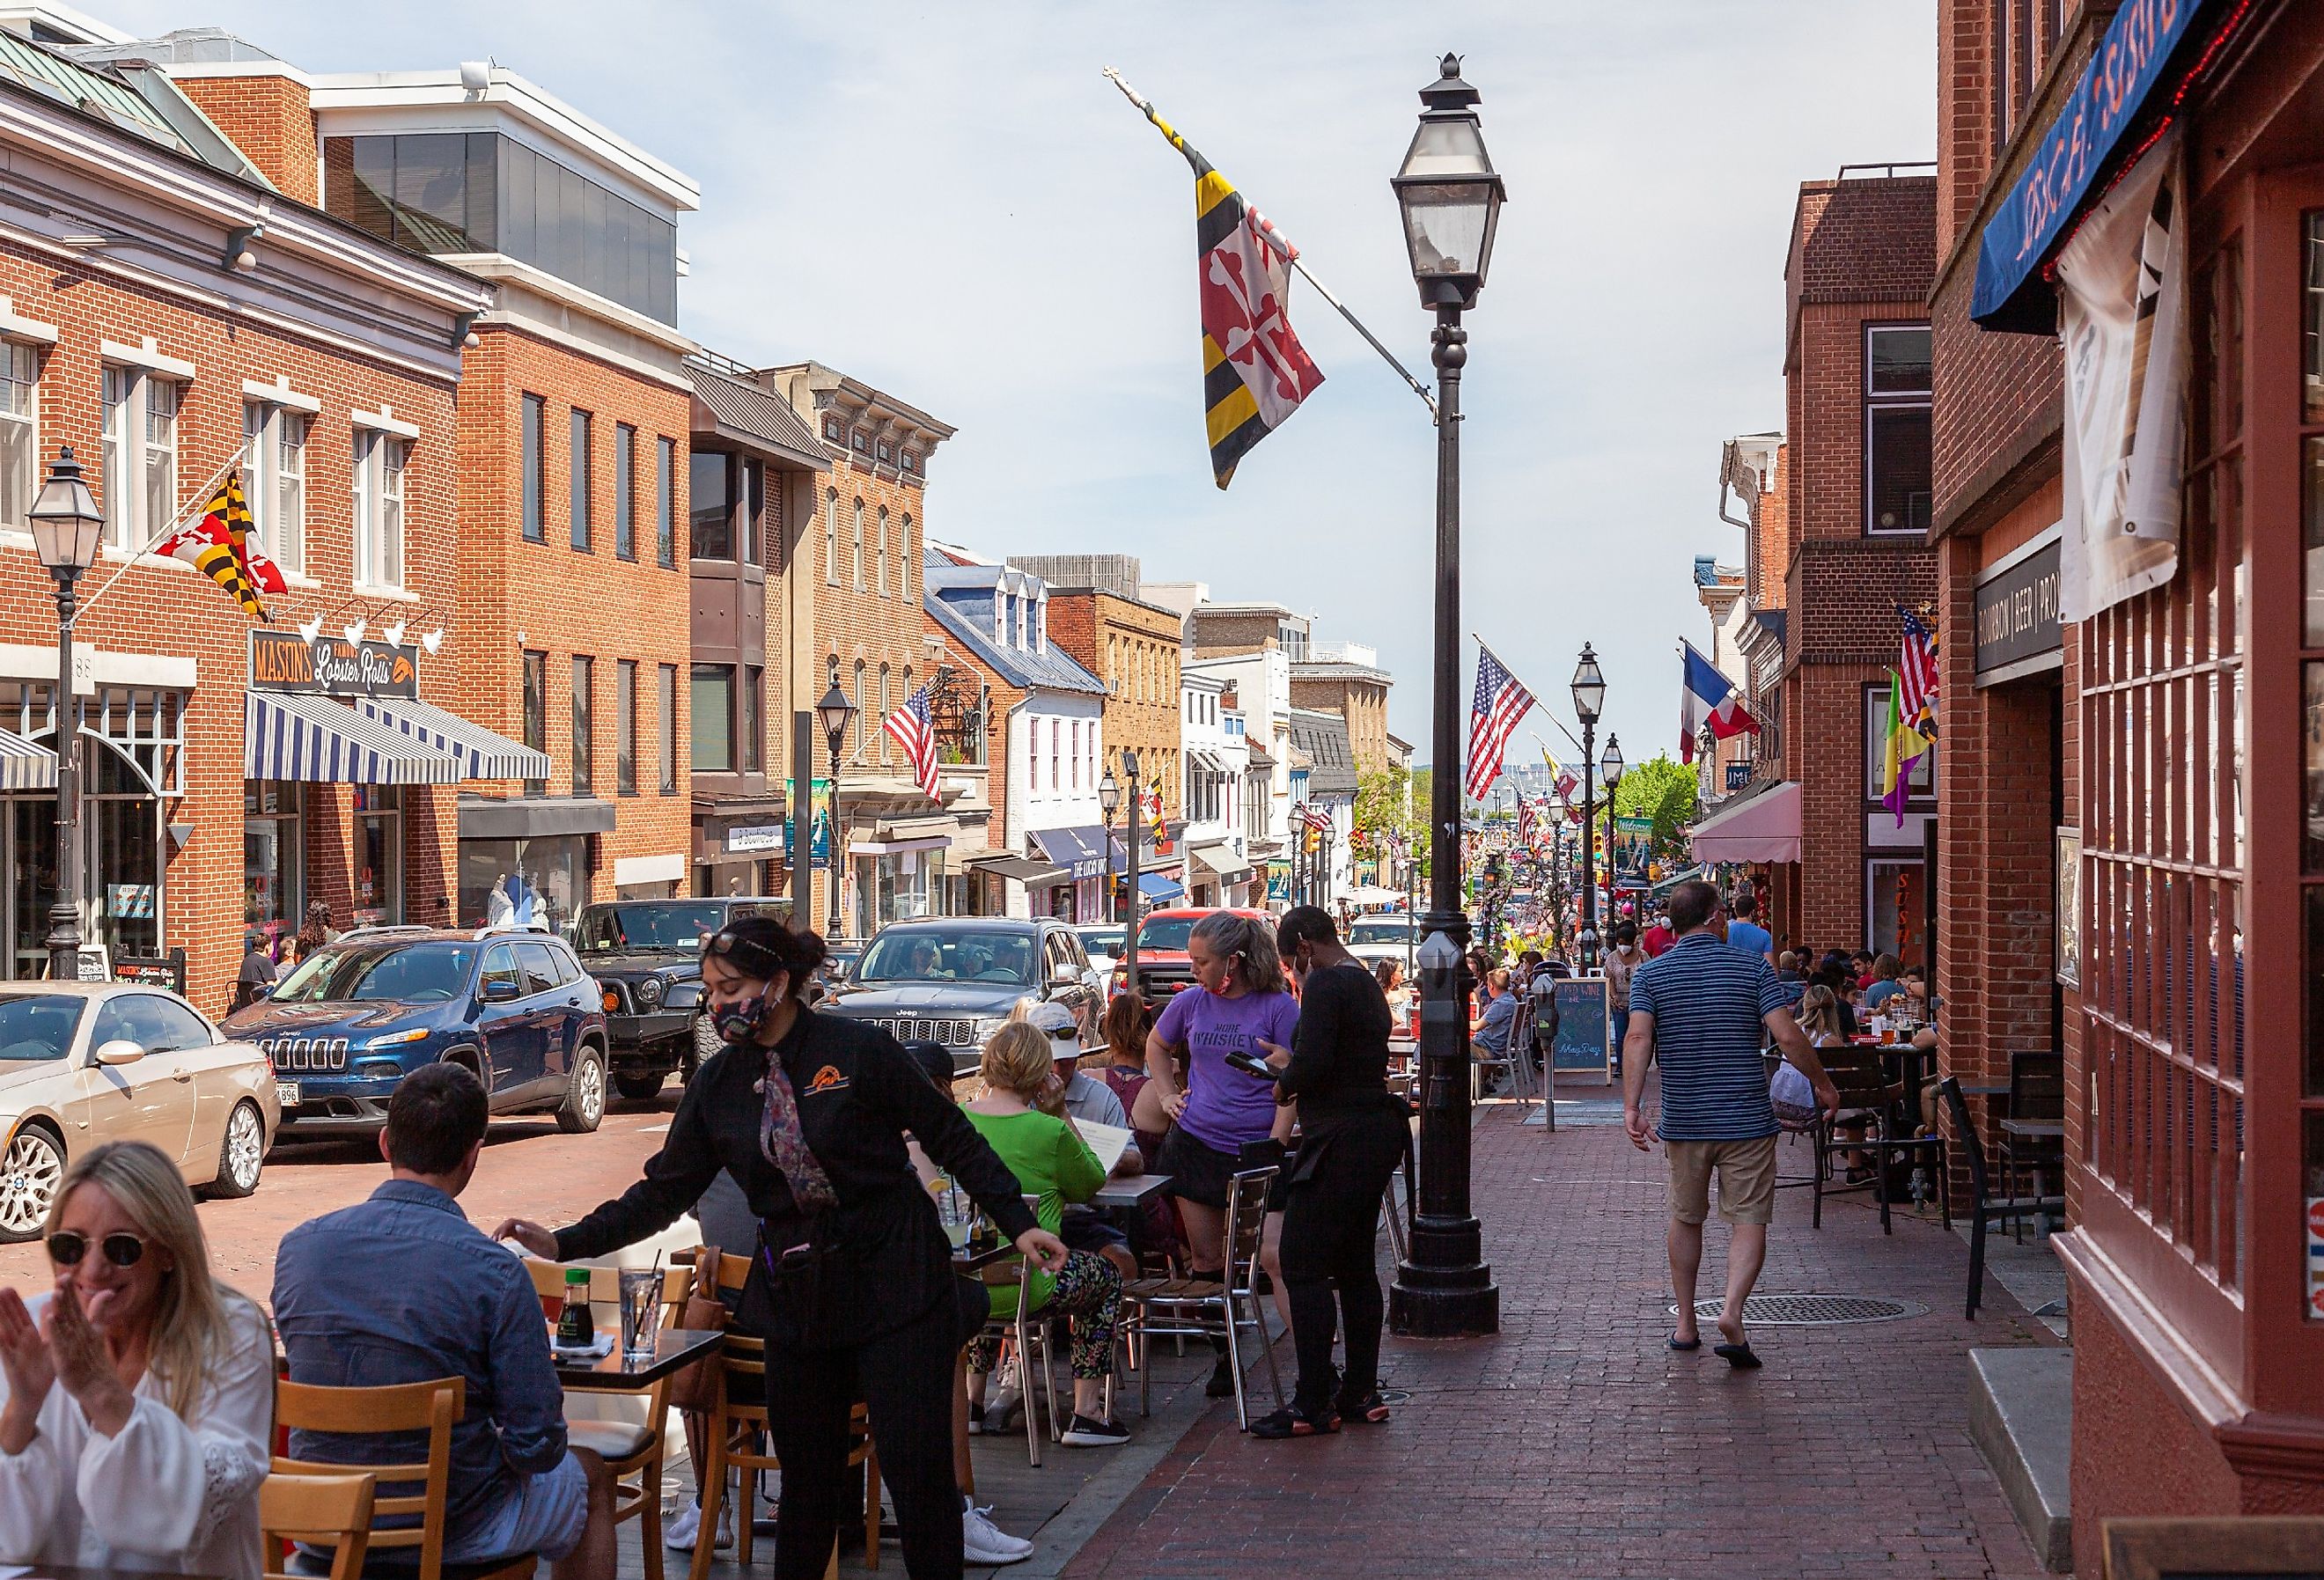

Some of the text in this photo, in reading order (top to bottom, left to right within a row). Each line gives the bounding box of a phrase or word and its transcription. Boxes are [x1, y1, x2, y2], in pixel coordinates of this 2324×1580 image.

[1979, 598, 2009, 648] BOURBON
[2015, 586, 2033, 633] BEER
[334, 643, 357, 658] FAMOUS
[70, 658, 91, 678] 88
[314, 643, 390, 692] Lobster Rolls
[1619, 819, 1650, 831] Welcome
[1073, 861, 1084, 878] THE
[1894, 872, 1911, 962] SUSHI
[1216, 1023, 1241, 1033] MORE
[1194, 1032, 1255, 1048] WHISKEY
[276, 1089, 298, 1101] 896
